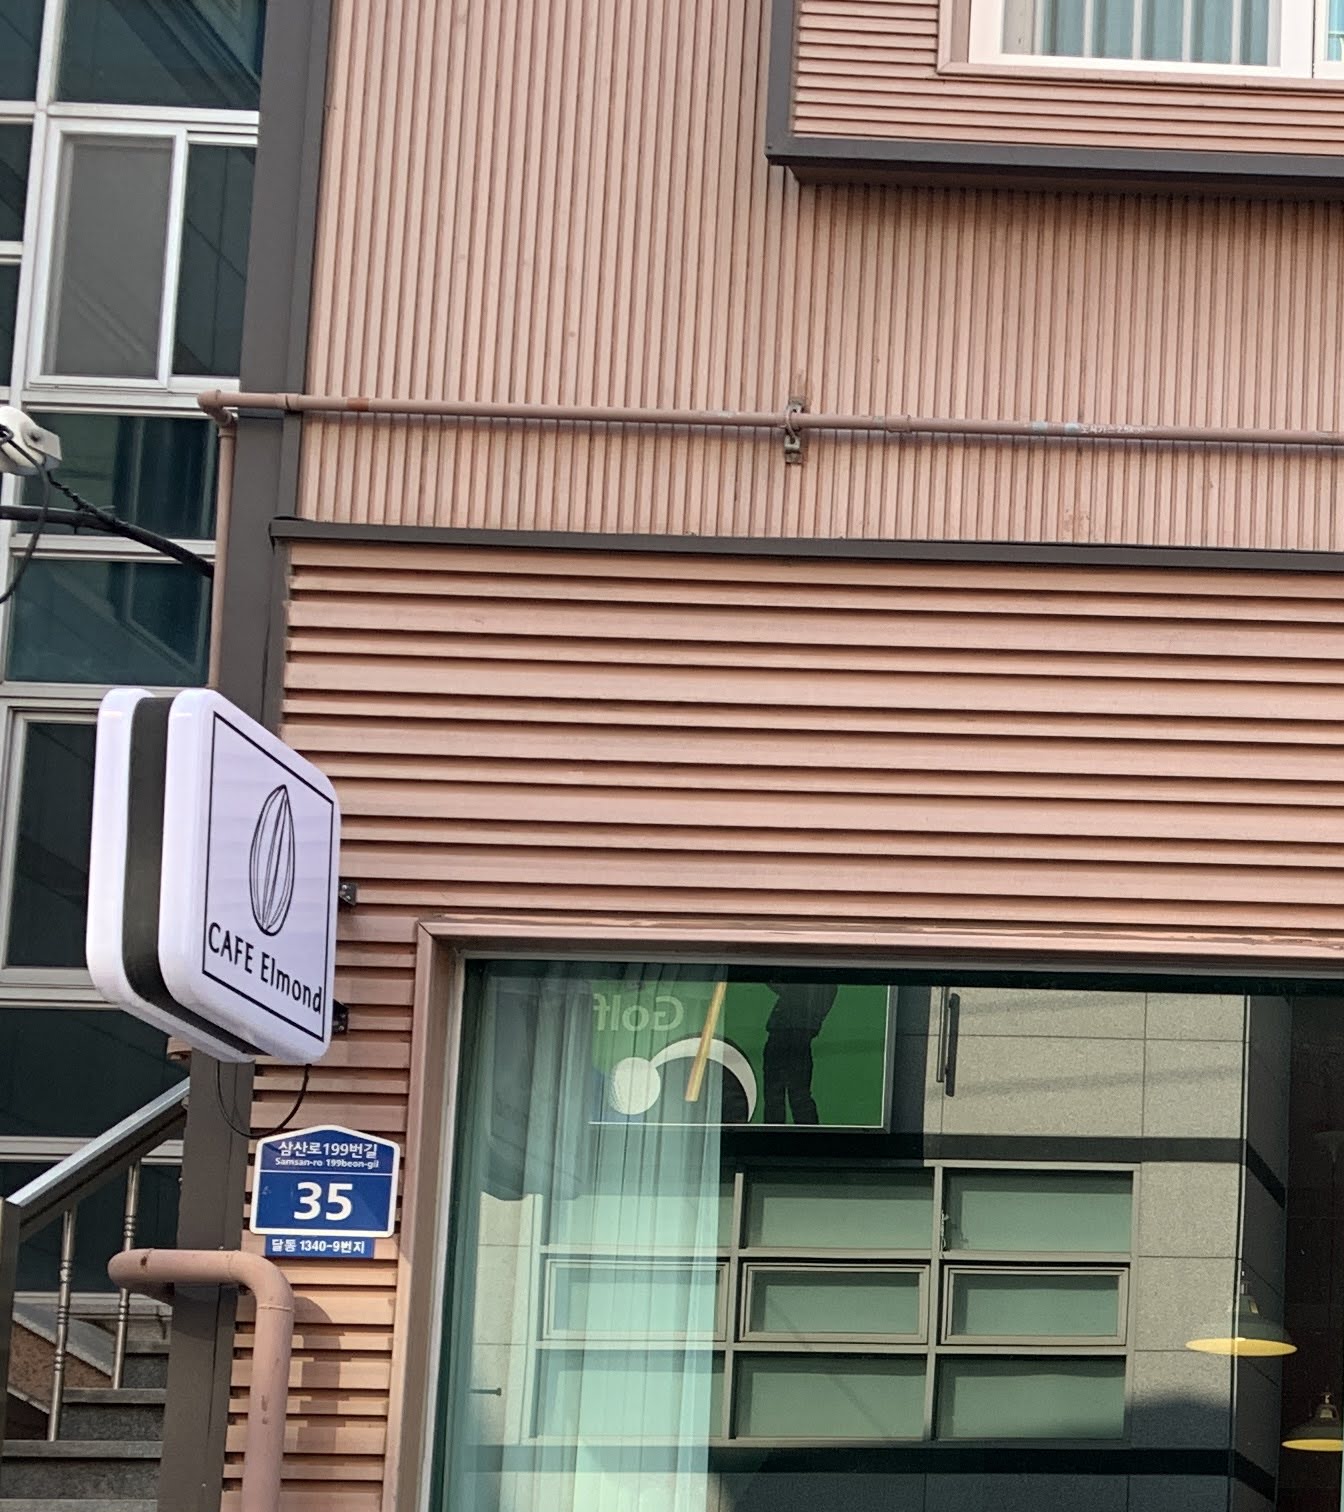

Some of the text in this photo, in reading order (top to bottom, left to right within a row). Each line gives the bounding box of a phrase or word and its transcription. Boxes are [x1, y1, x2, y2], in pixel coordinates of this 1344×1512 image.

[208, 921, 322, 1015] CAFE Elmond
[278, 1140, 378, 1159] 삼산로199번길
[275, 1157, 379, 1169] Samsan-ro 199beon-gil
[293, 1181, 353, 1221] 35
[271, 1238, 365, 1254] 달동 1340-9번지
